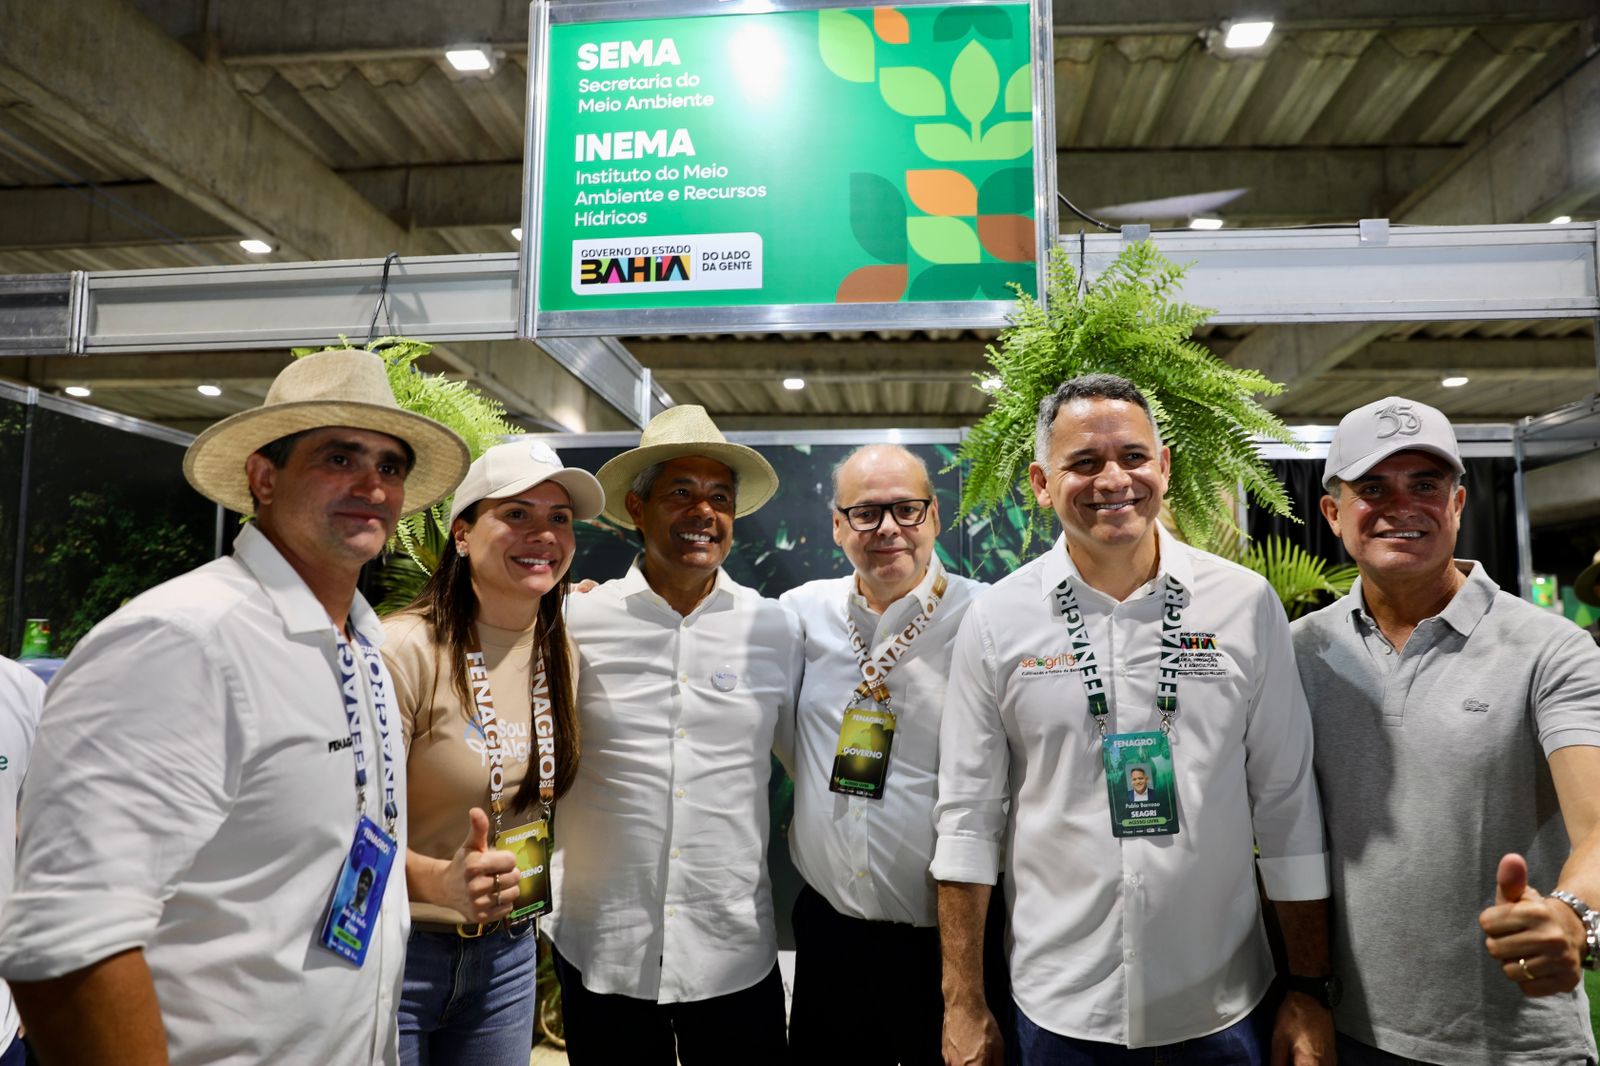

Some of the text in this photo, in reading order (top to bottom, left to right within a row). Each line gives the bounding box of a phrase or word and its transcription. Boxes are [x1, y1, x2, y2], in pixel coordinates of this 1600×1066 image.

[577, 38, 681, 71] SEMA
[578, 71, 700, 93] Secretaria do
[578, 92, 715, 114] Meio Ambiente
[575, 128, 697, 163] INEMA
[576, 163, 729, 185] Instituto do Meio
[575, 184, 767, 206] Ambiente e Recursos
[575, 210, 648, 227] Hídricos
[581, 245, 692, 258] GOVERNO DO ESTADO
[702, 251, 751, 261] DO LADO
[580, 255, 691, 285] BAHIA
[702, 261, 752, 271] DA GENTE
[1180, 637, 1217, 650] AHIA
[466, 651, 504, 792] FENAGRO
[498, 718, 527, 738] Sou
[843, 746, 883, 759] GOVERNO
[1113, 738, 1154, 748] FENAGRO
[1131, 810, 1157, 818] SEAGRI
